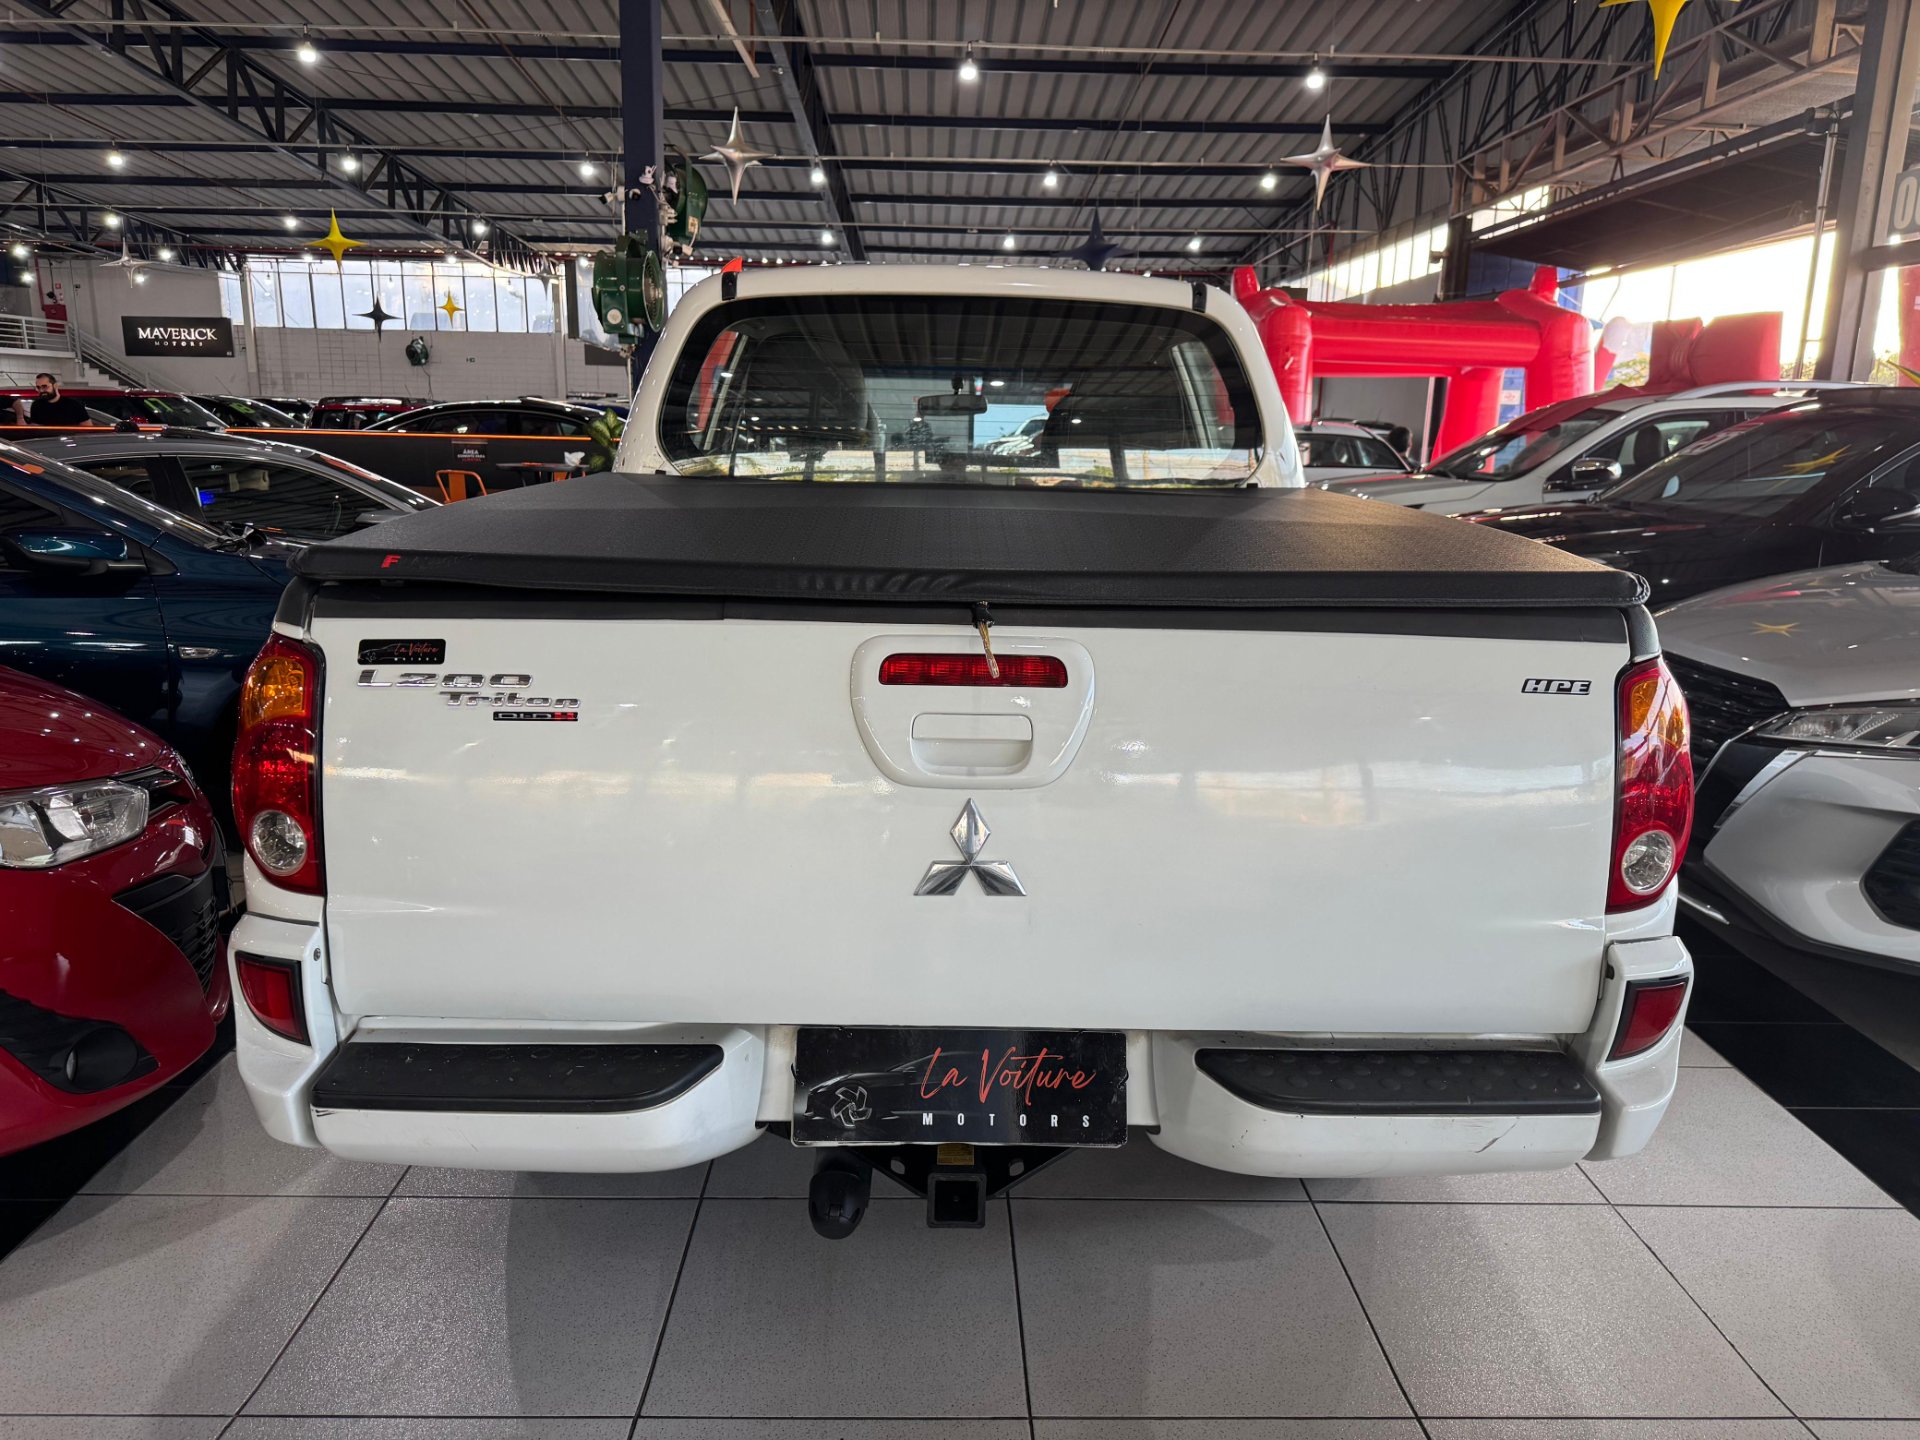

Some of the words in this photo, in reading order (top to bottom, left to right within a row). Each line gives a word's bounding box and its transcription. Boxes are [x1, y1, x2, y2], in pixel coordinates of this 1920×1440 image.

[138, 328, 217, 340] MAVERICK
[357, 669, 534, 688] L200
[1523, 679, 1591, 694] HPE
[439, 692, 581, 708] Triton
[920, 1047, 968, 1099] La
[977, 1046, 1097, 1106] Voiture
[922, 1112, 1090, 1128] MOTORS
